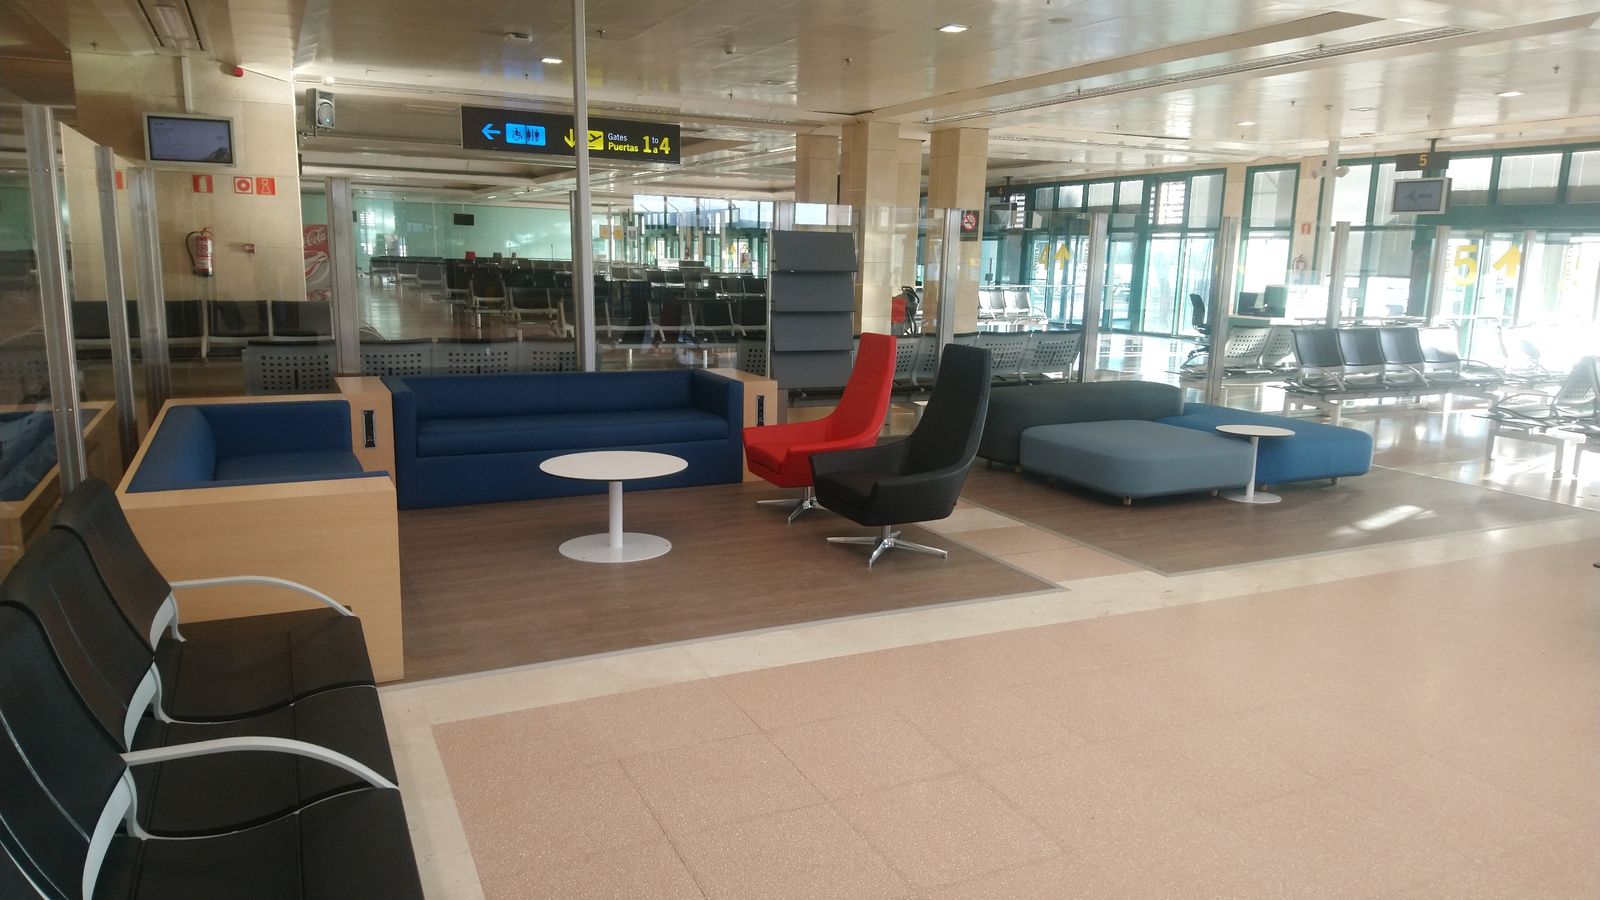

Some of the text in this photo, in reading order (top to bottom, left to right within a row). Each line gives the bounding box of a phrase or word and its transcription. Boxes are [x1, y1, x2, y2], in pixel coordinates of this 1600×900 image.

[607, 132, 628, 142] Gates
[608, 142, 639, 152] Puertas
[643, 136, 652, 153] 1
[659, 137, 671, 154] 4
[1418, 154, 1428, 167] 5
[1454, 244, 1478, 287] 5
